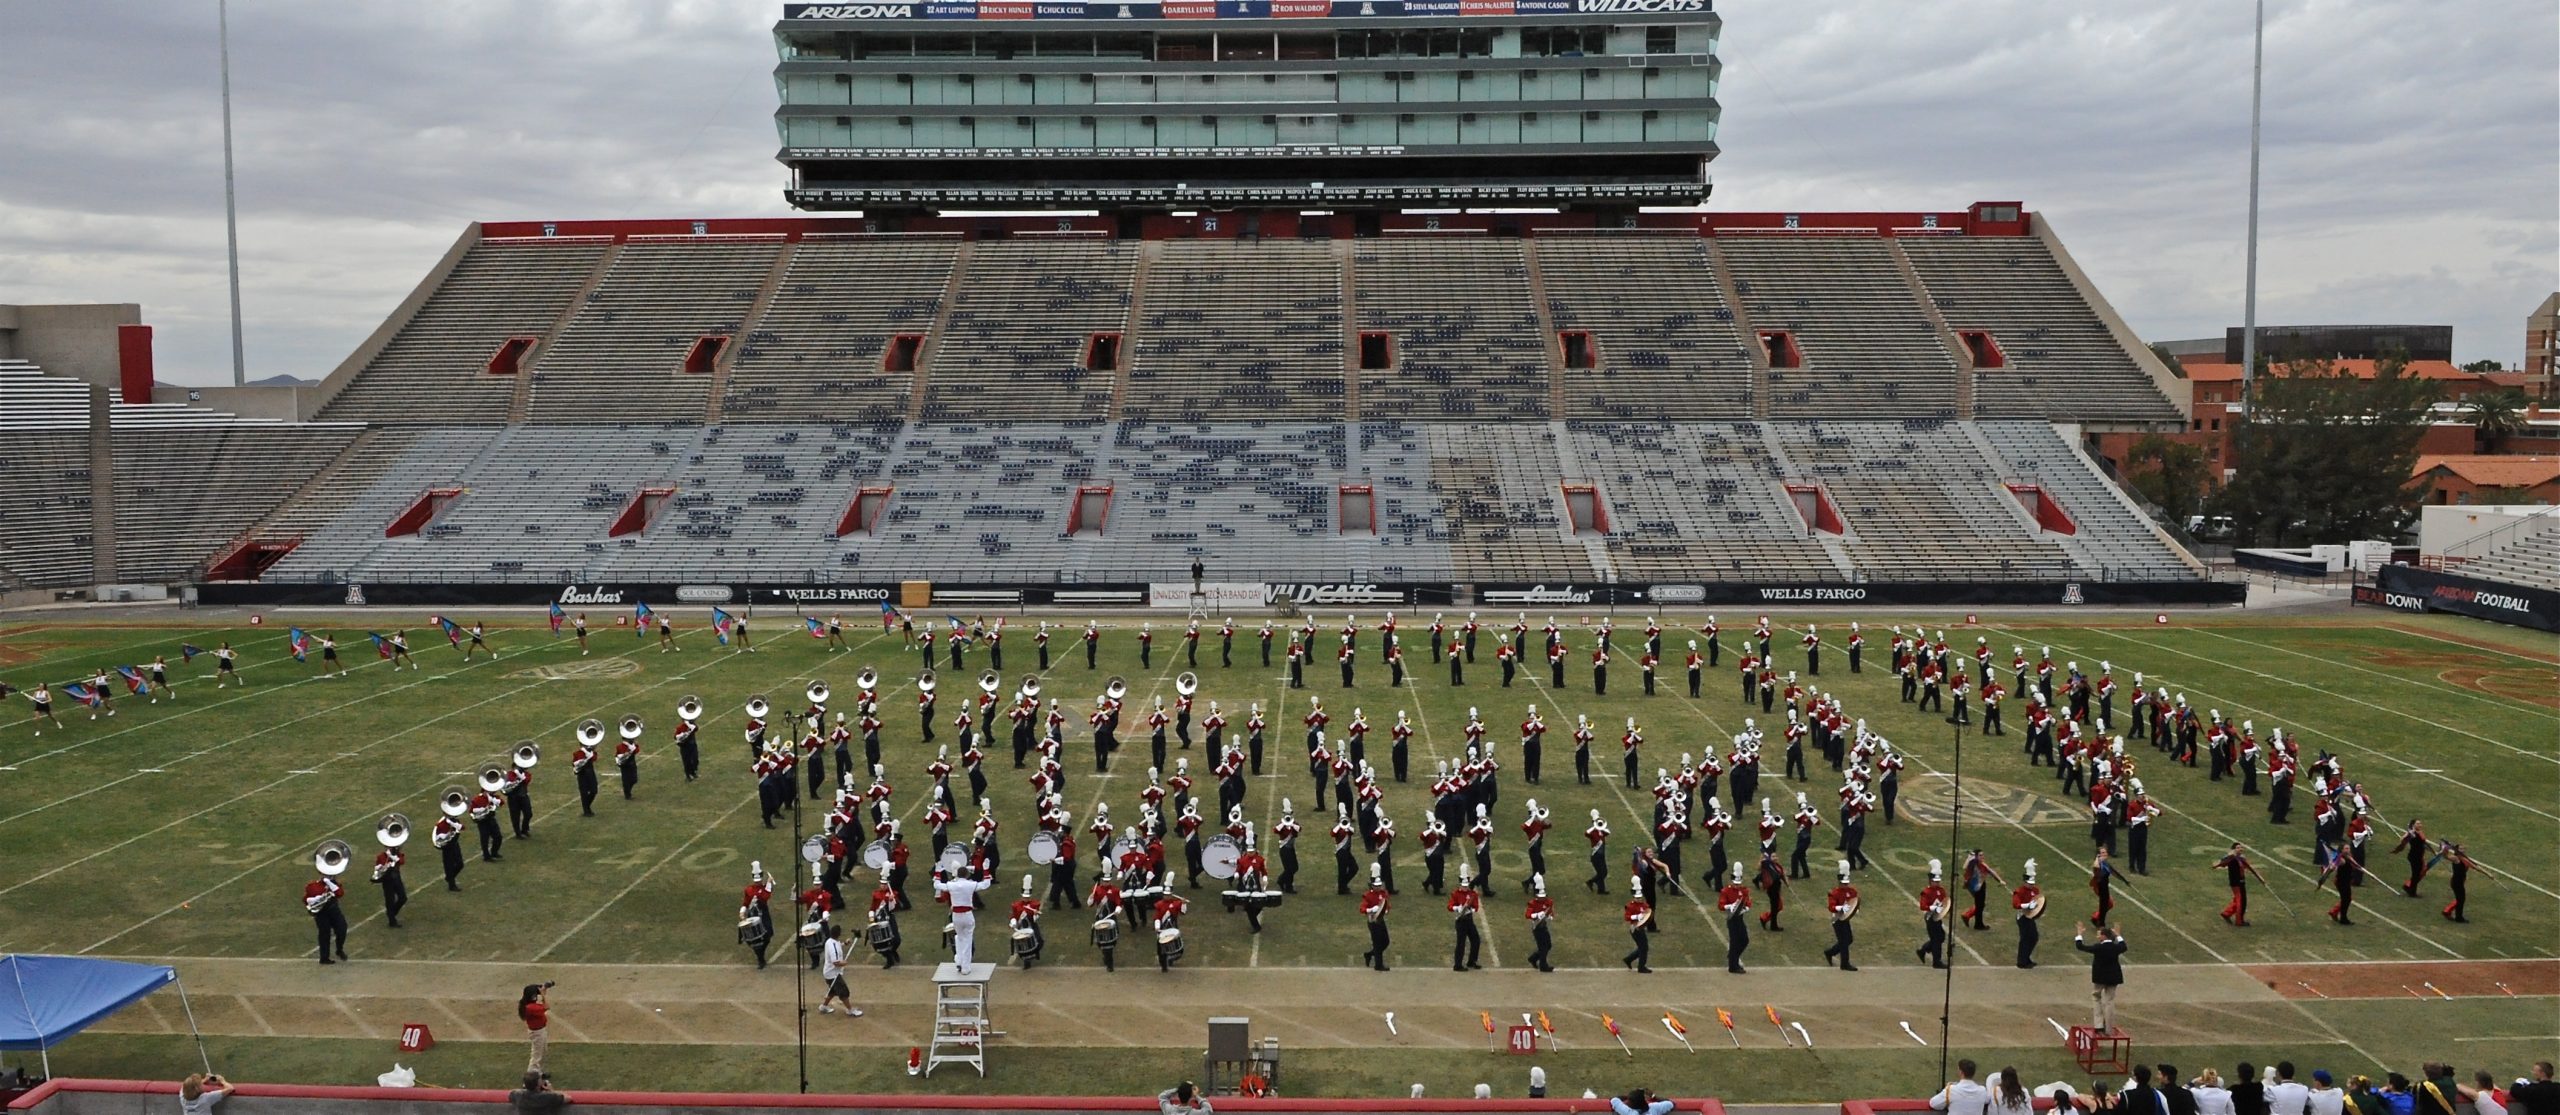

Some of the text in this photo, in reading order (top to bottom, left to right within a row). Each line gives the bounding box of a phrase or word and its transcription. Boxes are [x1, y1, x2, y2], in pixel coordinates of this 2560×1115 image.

[948, 6, 976, 14] LUPPINO
[1043, 6, 1066, 14] CHUCK
[1066, 6, 1084, 14] CECIL
[1162, 6, 1167, 14] 4
[1578, 0, 1704, 12] WILDCATS
[797, 5, 912, 19] ARIZONA
[1057, 222, 1071, 231] 20
[1205, 221, 1217, 231] 21
[1426, 220, 1439, 230] 22
[1624, 219, 1637, 229] 23
[1785, 219, 1798, 228] 24
[1923, 219, 1937, 228] 25
[544, 228, 556, 237] 17
[694, 226, 706, 236] 18
[190, 391, 201, 400] 16
[345, 584, 366, 604] A
[559, 585, 624, 603] Bashas'
[785, 588, 890, 600] WELLS FARGO
[1153, 590, 1187, 600] UNIVERSITY
[1229, 590, 1247, 600] BAND
[1248, 590, 1262, 600] DAY
[1669, 589, 1701, 597] CASINOS
[1760, 588, 1866, 600] WELLS FARGO
[2062, 583, 2084, 604] A
[2356, 588, 2423, 610] BEAR DOWN
[2432, 585, 2530, 612] ARIZONA FOOTBALL
[402, 1027, 421, 1048] 40
[960, 1030, 975, 1046] 50
[1512, 1030, 1531, 1050] 40
